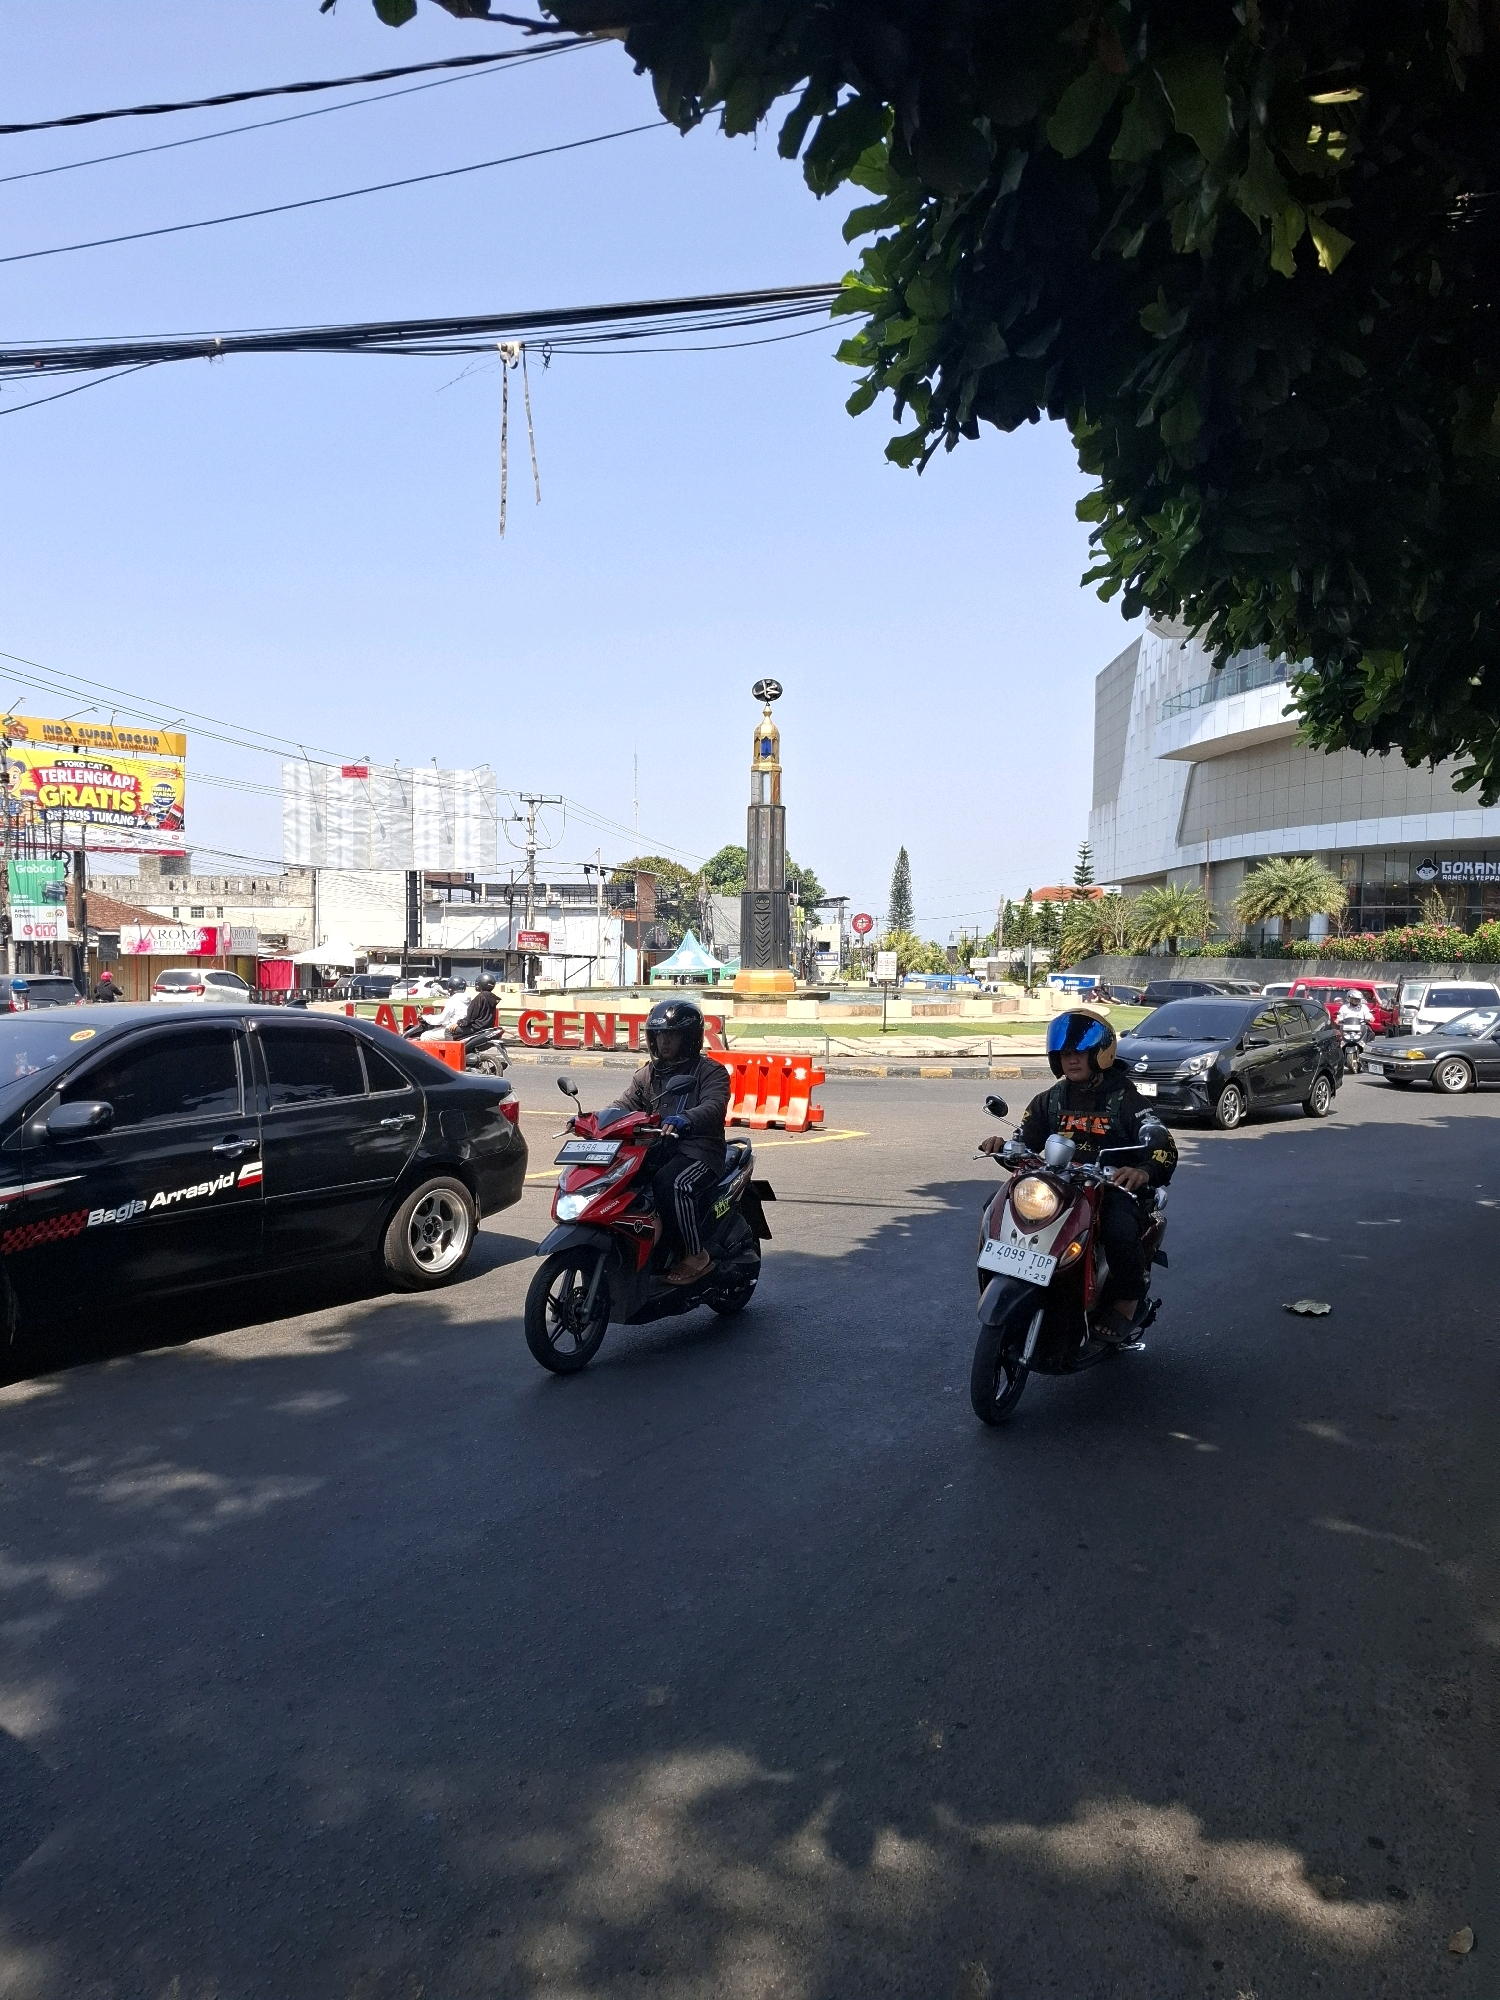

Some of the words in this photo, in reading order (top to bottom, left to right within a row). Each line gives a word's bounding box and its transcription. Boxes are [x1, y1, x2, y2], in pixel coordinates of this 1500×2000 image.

[42, 724, 72, 736] INDO
[78, 727, 113, 740] SUPER
[118, 733, 160, 747] GROSIR
[44, 734, 91, 746] SUPERMARKET
[39, 769, 136, 790] TERLENGKAP!
[39, 785, 137, 812] GRATIS
[16, 864, 57, 874] GrabCar
[1441, 861, 1500, 875] GOKAN
[36, 926, 57, 936] 110
[144, 929, 209, 940] AROMA
[153, 940, 201, 948] PERFUME
[517, 1009, 725, 1051] GENTR
[87, 1199, 147, 1227] Bagja
[149, 1172, 234, 1210] Arrasyid
[600, 1200, 620, 1215] HONDA
[985, 1242, 993, 1252] B
[996, 1245, 1026, 1262] 4099
